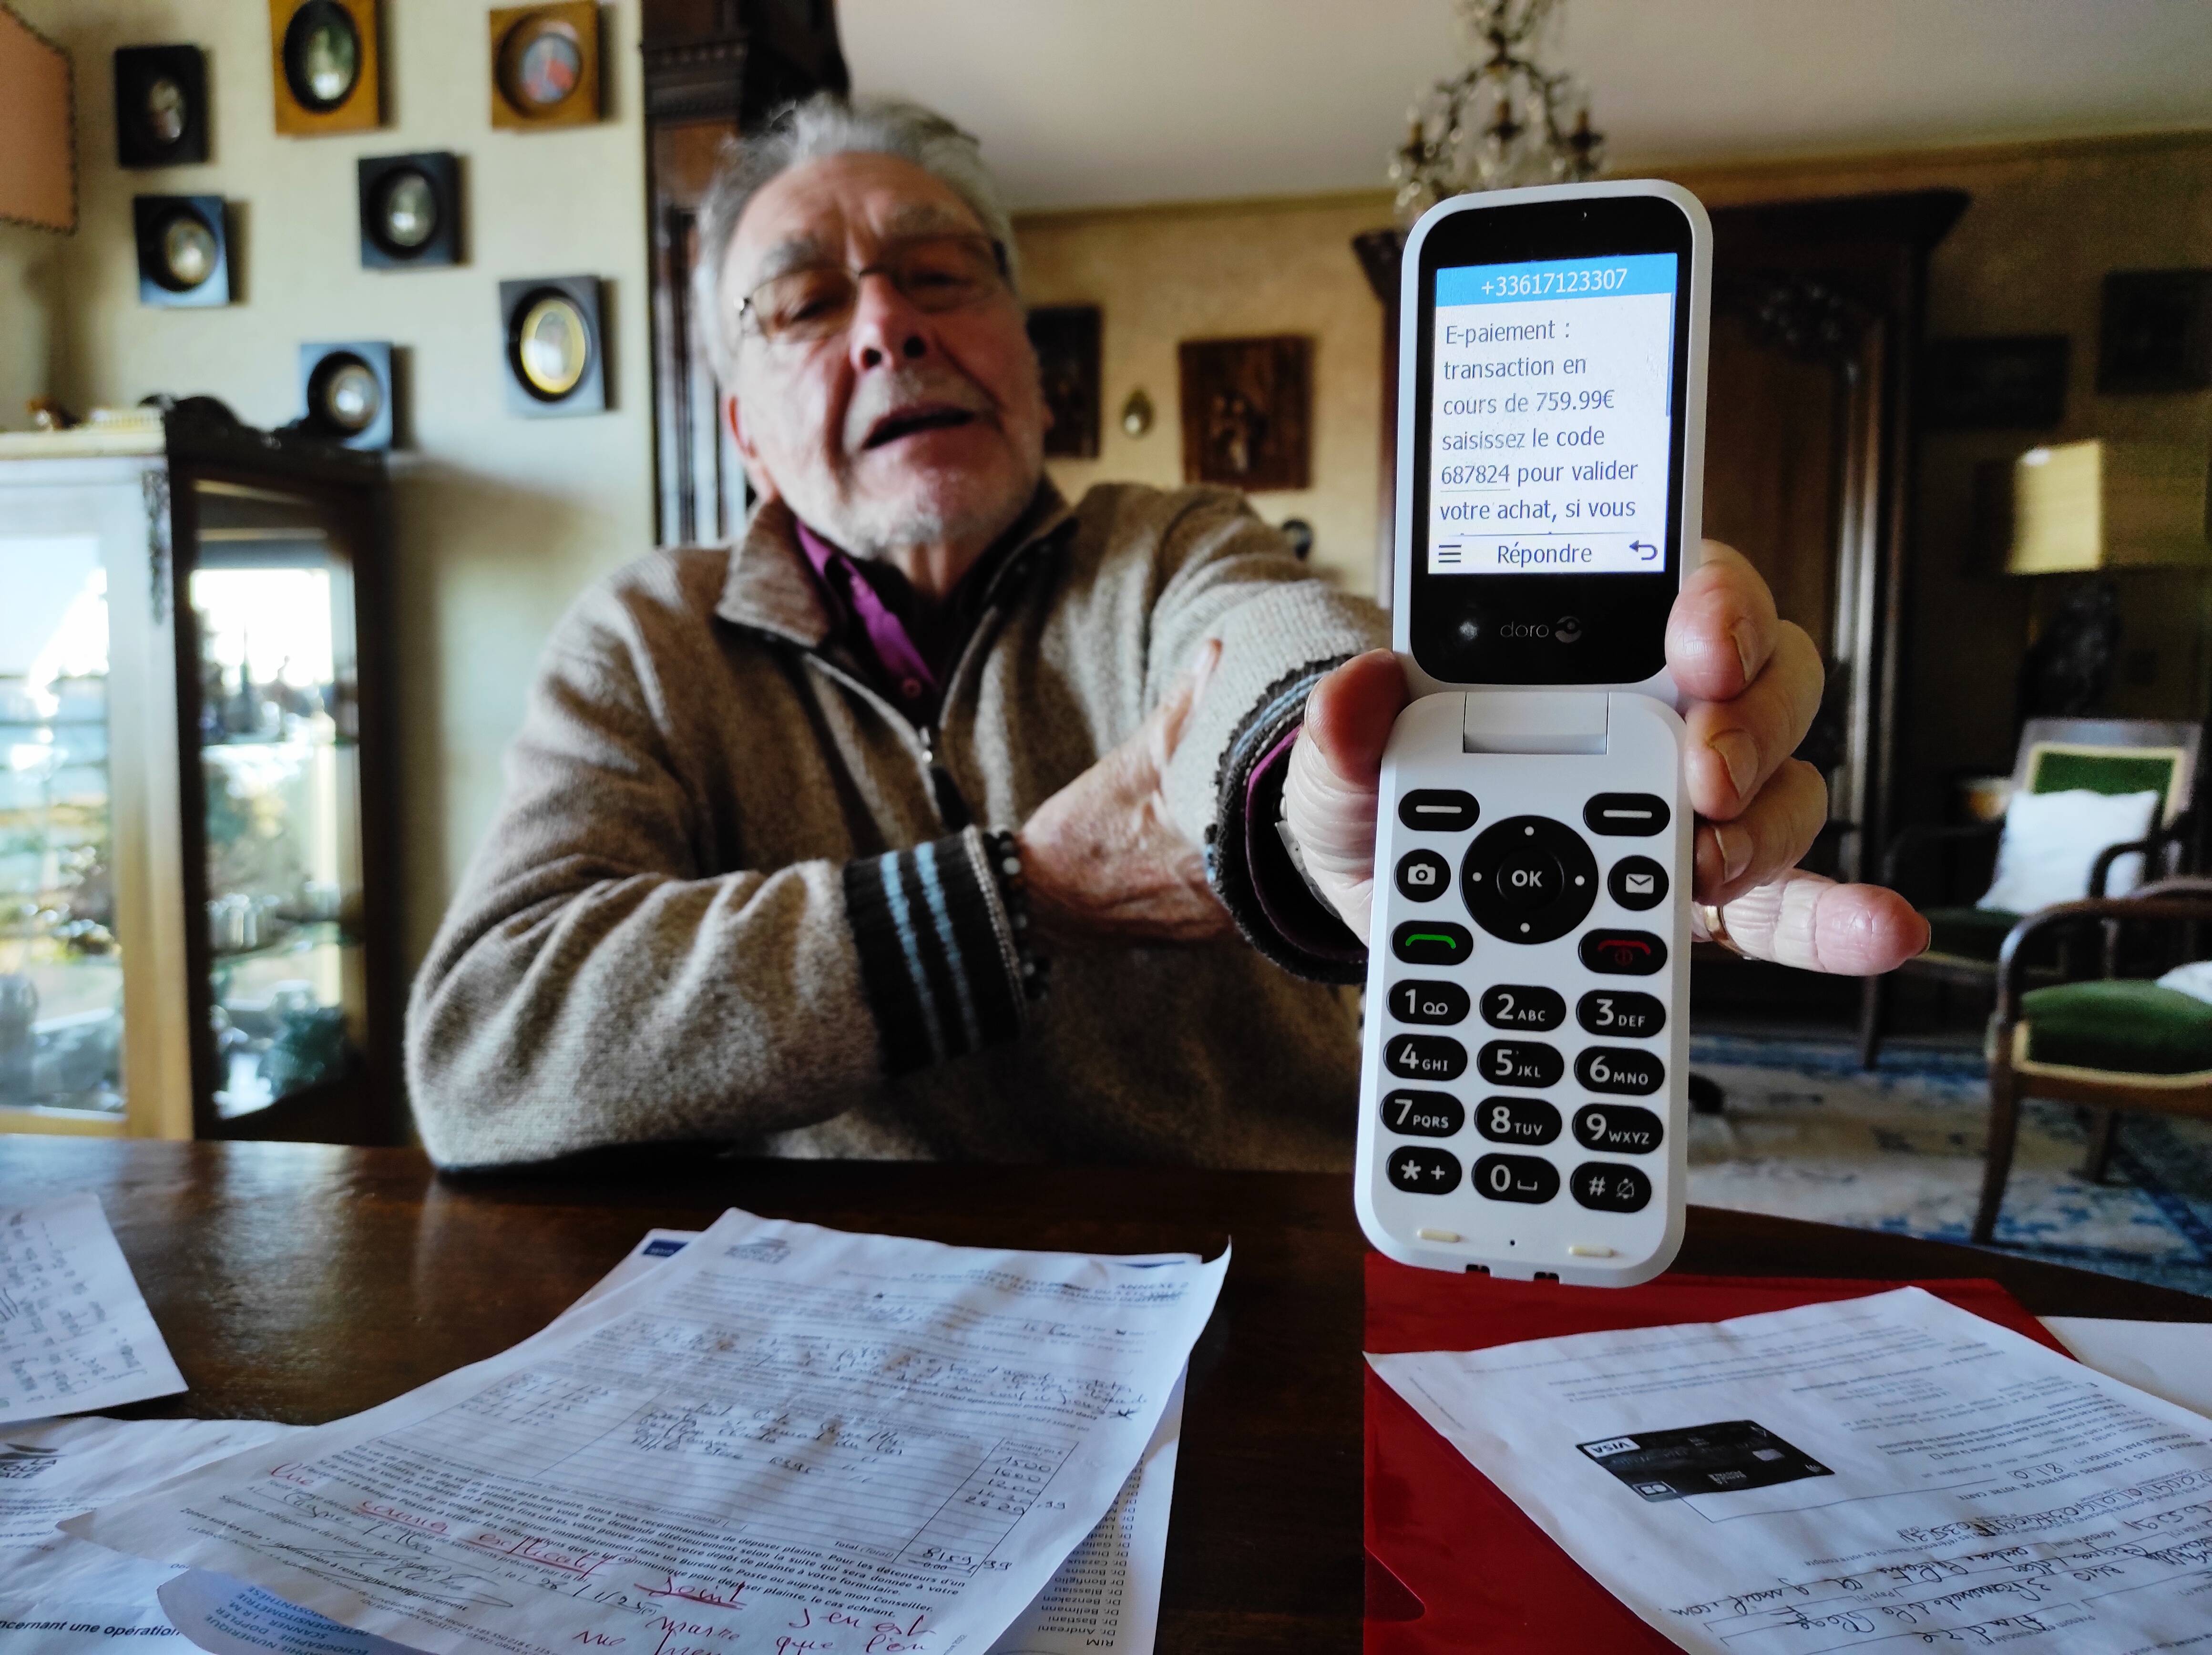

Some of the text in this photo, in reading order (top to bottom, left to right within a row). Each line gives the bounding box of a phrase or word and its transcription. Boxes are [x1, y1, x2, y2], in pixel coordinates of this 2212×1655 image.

[1481, 268, 1628, 296] +33617123307
[1444, 358, 1587, 380] transaction en
[1444, 389, 1615, 415] cours de 759.99€
[1442, 426, 1605, 450] saisissez le code
[1441, 460, 1639, 488] 687824 pour valider
[1440, 498, 1636, 523] votre achat, si vous
[1497, 541, 1592, 568] Répondre
[1500, 622, 1549, 639] doro
[1511, 870, 1543, 888] OK
[1405, 989, 1416, 1014] 1
[1496, 994, 1546, 1022] 2 ABC
[1596, 999, 1646, 1028] 3 DEF
[1399, 1043, 1448, 1072] 4 GHI
[1495, 1050, 1541, 1078] 5 JKL
[1590, 1056, 1649, 1085] 6 MNO
[1395, 1099, 1449, 1129] 7 PQRS
[1491, 1106, 1543, 1136] 8 TUV
[1587, 1113, 1650, 1145] 9 WXYZ
[1590, 1440, 1631, 1454] VISA
[2125, 1440, 2141, 1450] PAR
[2133, 1451, 2151, 1460] LES
[2036, 1471, 2078, 1485] CHIFFRES
[2079, 1460, 2123, 1474] DERNIERS
[1956, 1491, 1987, 1500] CARTE
[1988, 1485, 2019, 1495] VOTRE
[513, 1490, 539, 1499] carte
[587, 1506, 613, 1515] nous
[616, 1512, 639, 1522] vous
[641, 1519, 719, 1540] recommandons
[828, 1554, 855, 1564] Pour
[857, 1561, 873, 1570] les
[876, 1565, 937, 1583] détenteurs
[835, 1541, 859, 1550] Total
[2081, 1530, 2117, 1543] Adresse
[361, 1485, 398, 1500] Banque
[399, 1498, 436, 1512] Postale
[482, 1521, 498, 1529] les
[568, 1544, 588, 1553] que
[763, 1588, 807, 1602] plainte,
[825, 1600, 844, 1608] cas
[847, 1604, 896, 1617] échéant.
[516, 1508, 536, 1517] fins
[573, 1522, 595, 1531] vous
[596, 1528, 635, 1541] pouvez
[635, 1536, 675, 1549] joindre
[677, 1545, 705, 1555] votre
[707, 1552, 739, 1562] dépôt
[754, 1561, 795, 1573] plainte
[808, 1571, 837, 1581] votre
[840, 1577, 901, 1595] formulaire.
[557, 1509, 580, 1517] vous
[583, 1514, 605, 1522] être
[658, 1530, 737, 1551] ultérieurement
[740, 1549, 770, 1558] selon
[789, 1557, 816, 1567] suite
[820, 1563, 840, 1572] qui
[843, 1568, 866, 1579] sera
[870, 1575, 912, 1588] donnée
[929, 1586, 959, 1594] votre
[551, 1528, 634, 1551] immédiatement
[635, 1548, 660, 1557] dans
[663, 1554, 677, 1562] un
[679, 1558, 717, 1570] Bureau
[736, 1569, 768, 1580] Poste
[787, 1580, 825, 1592] auprès
[845, 1592, 871, 1601] mon
[873, 1596, 933, 1612] Conseiller.
[1054, 1576, 1106, 1585] Bonfiglio
[215, 1606, 269, 1635] DOPPLER
[1041, 1605, 1099, 1615] Bellmann
[2057, 1614, 2096, 1628] Prénom
[69, 1623, 101, 1633] une
[104, 1625, 181, 1637] opération
[268, 1619, 329, 1640] SCANNER
[1037, 1624, 1095, 1635] Andreani
[1086, 1638, 1114, 1647] RIM
